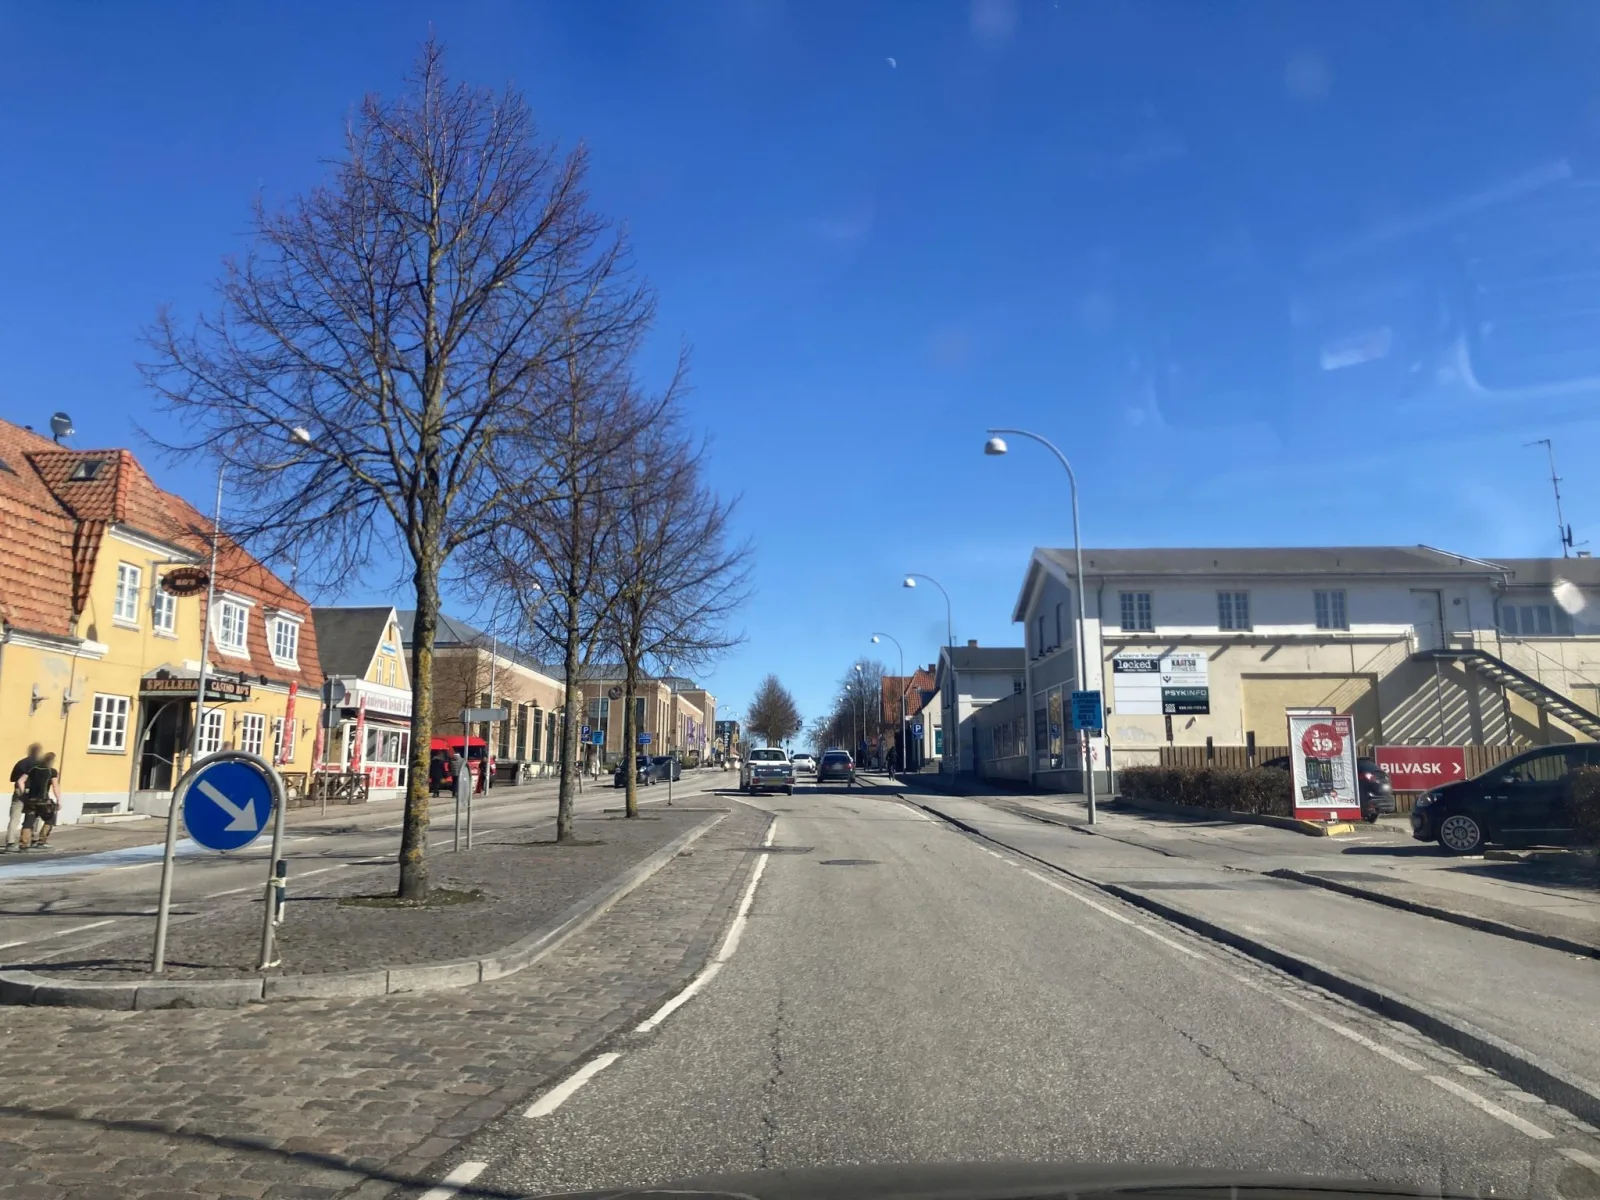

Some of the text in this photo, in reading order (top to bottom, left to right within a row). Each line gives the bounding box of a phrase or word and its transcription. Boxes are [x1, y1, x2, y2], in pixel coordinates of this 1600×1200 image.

[1117, 659, 1152, 669] locked
[146, 680, 200, 690] SPILLEHA
[211, 681, 235, 693] CASINO
[583, 726, 589, 734] P
[915, 724, 921, 732] P
[1312, 729, 1320, 738] 3
[1380, 762, 1442, 774] BILVASK
